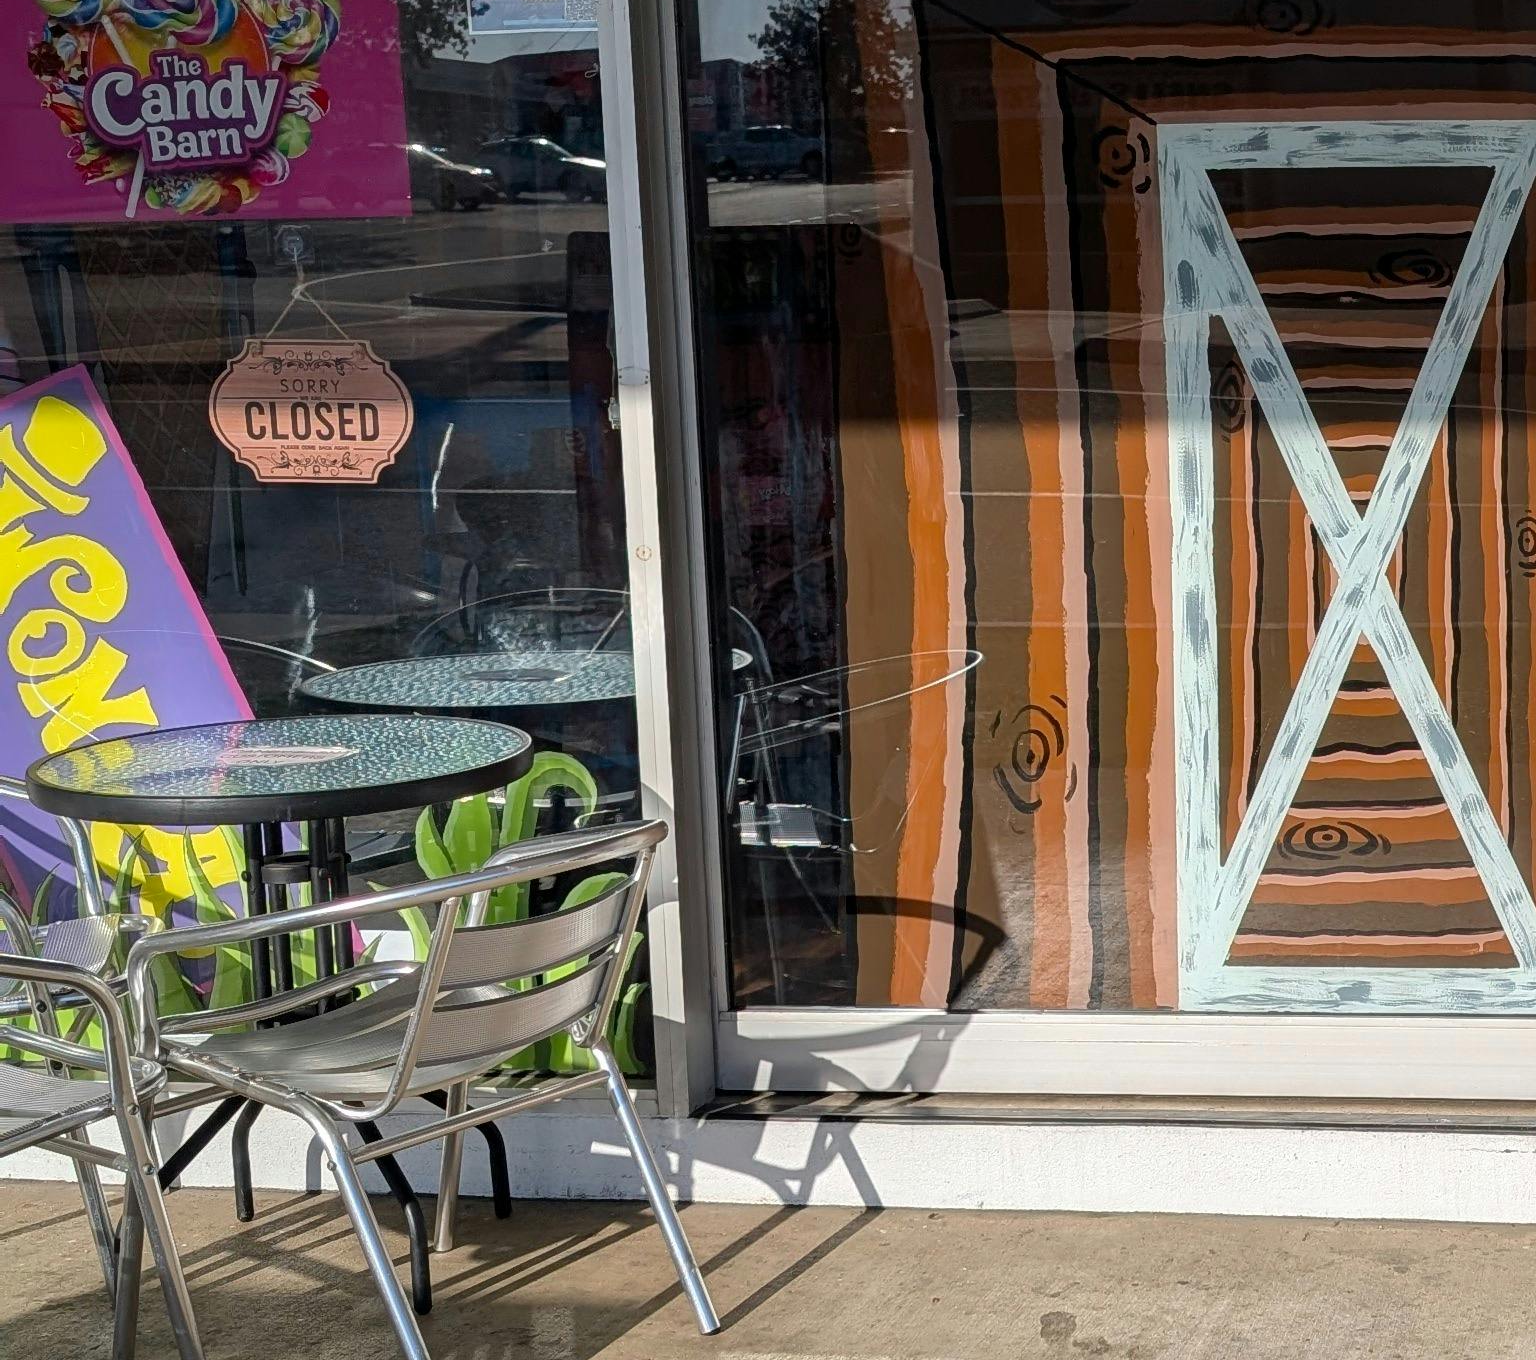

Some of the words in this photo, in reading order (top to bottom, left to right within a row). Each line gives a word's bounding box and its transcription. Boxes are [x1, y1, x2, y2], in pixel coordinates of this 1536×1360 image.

[157, 56, 201, 77] The
[91, 64, 279, 139] Candy
[147, 125, 242, 162] Barn
[280, 379, 340, 393] SORRY
[244, 401, 380, 441] CLOSED
